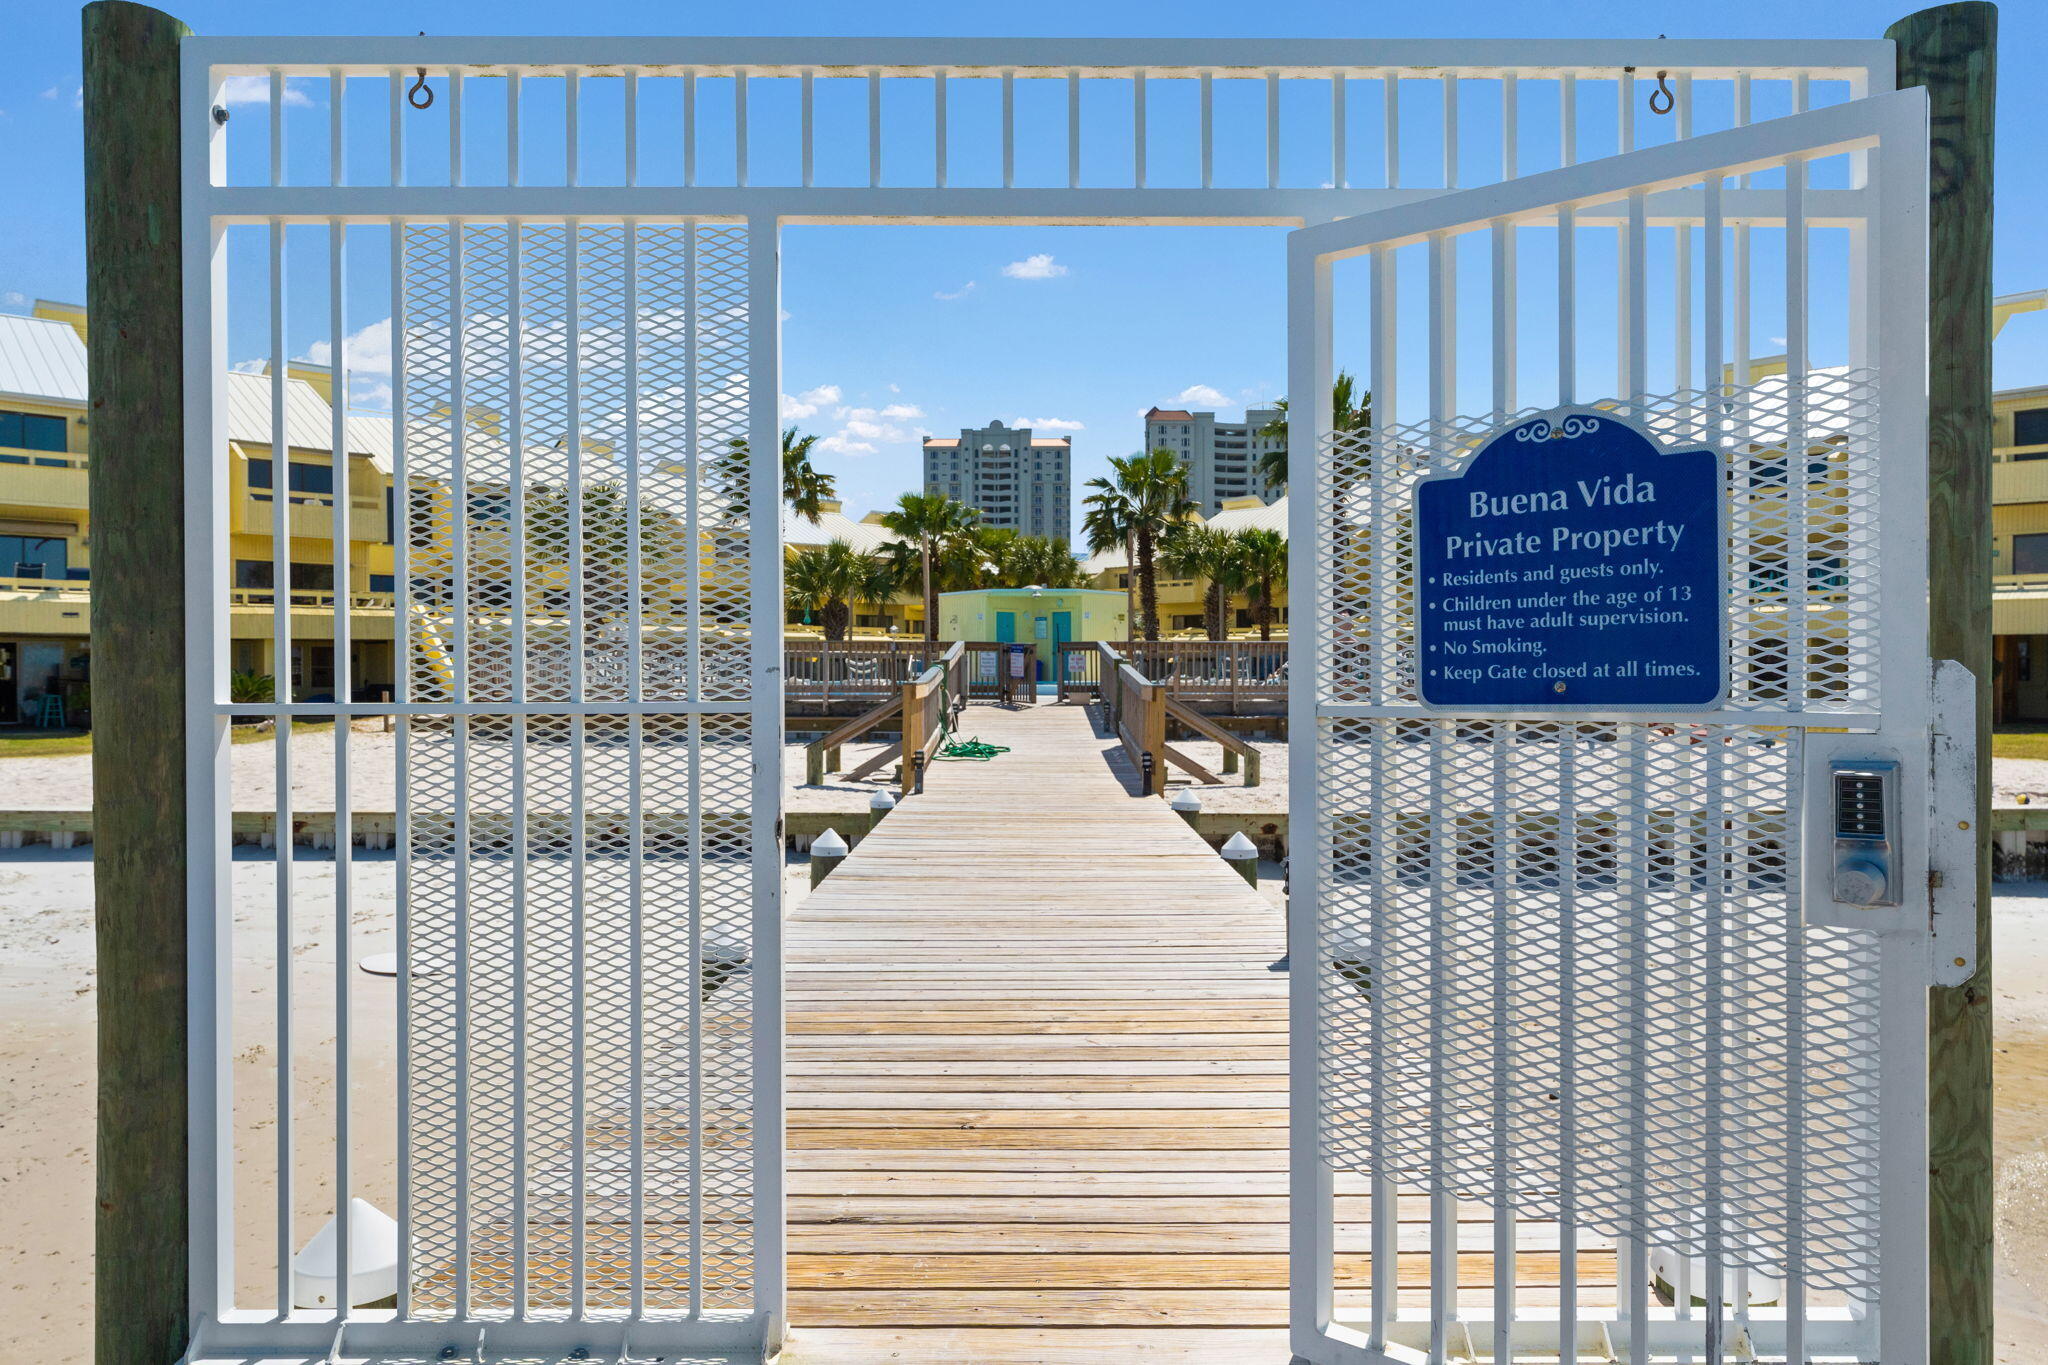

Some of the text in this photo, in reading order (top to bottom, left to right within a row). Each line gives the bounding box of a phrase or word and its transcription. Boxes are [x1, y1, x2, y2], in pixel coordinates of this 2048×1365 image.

[1470, 473, 1656, 517] Buena Vida
[1447, 521, 1684, 559] Private Property
[1444, 559, 1663, 586] Residents and guests only.
[1443, 586, 1691, 611] Children under the age of 13
[1444, 607, 1688, 631] must have adult supervision.
[1445, 638, 1546, 656] No Smoking.
[1445, 661, 1700, 683] Keep Gate closed at all times.
